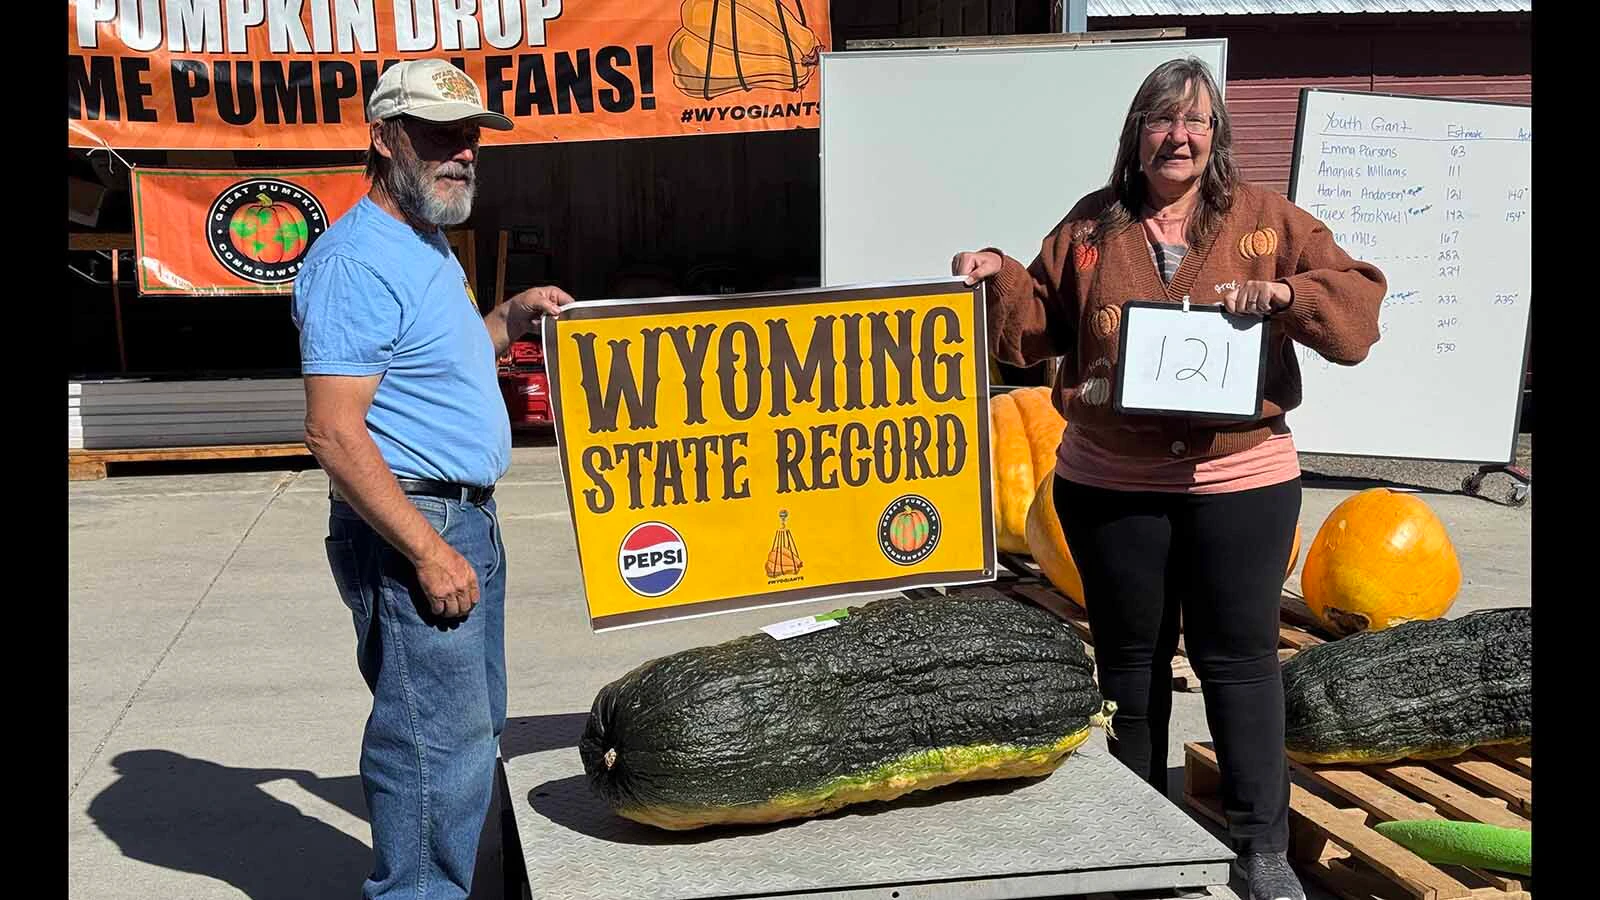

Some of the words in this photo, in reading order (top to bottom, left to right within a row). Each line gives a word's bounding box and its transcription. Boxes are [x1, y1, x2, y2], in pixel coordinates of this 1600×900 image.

[77, 0, 378, 54] PUMPKIN
[395, 0, 562, 50] DROP
[171, 56, 465, 125] PUMP
[485, 45, 656, 117] FANS!
[1322, 112, 1362, 132] Youth
[1371, 116, 1412, 133] Giant
[1321, 141, 1356, 155] Emma
[1359, 144, 1399, 159] Parsons
[1450, 145, 1466, 158] 63
[1318, 159, 1361, 178] Ananias
[1367, 164, 1408, 178] Williams
[1448, 164, 1461, 177] 111
[215, 187, 249, 221] GREAT
[259, 184, 320, 220] PUMPKIN
[1317, 183, 1352, 198] Harlan
[1360, 186, 1404, 201] Anderson
[1446, 208, 1465, 221] 142
[219, 243, 304, 277] COMMONWEA
[571, 306, 966, 433] WYOMING
[1156, 336, 1229, 389] 121
[582, 432, 750, 514] STATE
[774, 413, 968, 495] RECORD
[905, 498, 937, 521] PUMPKIN
[624, 549, 682, 570] PEPSI
